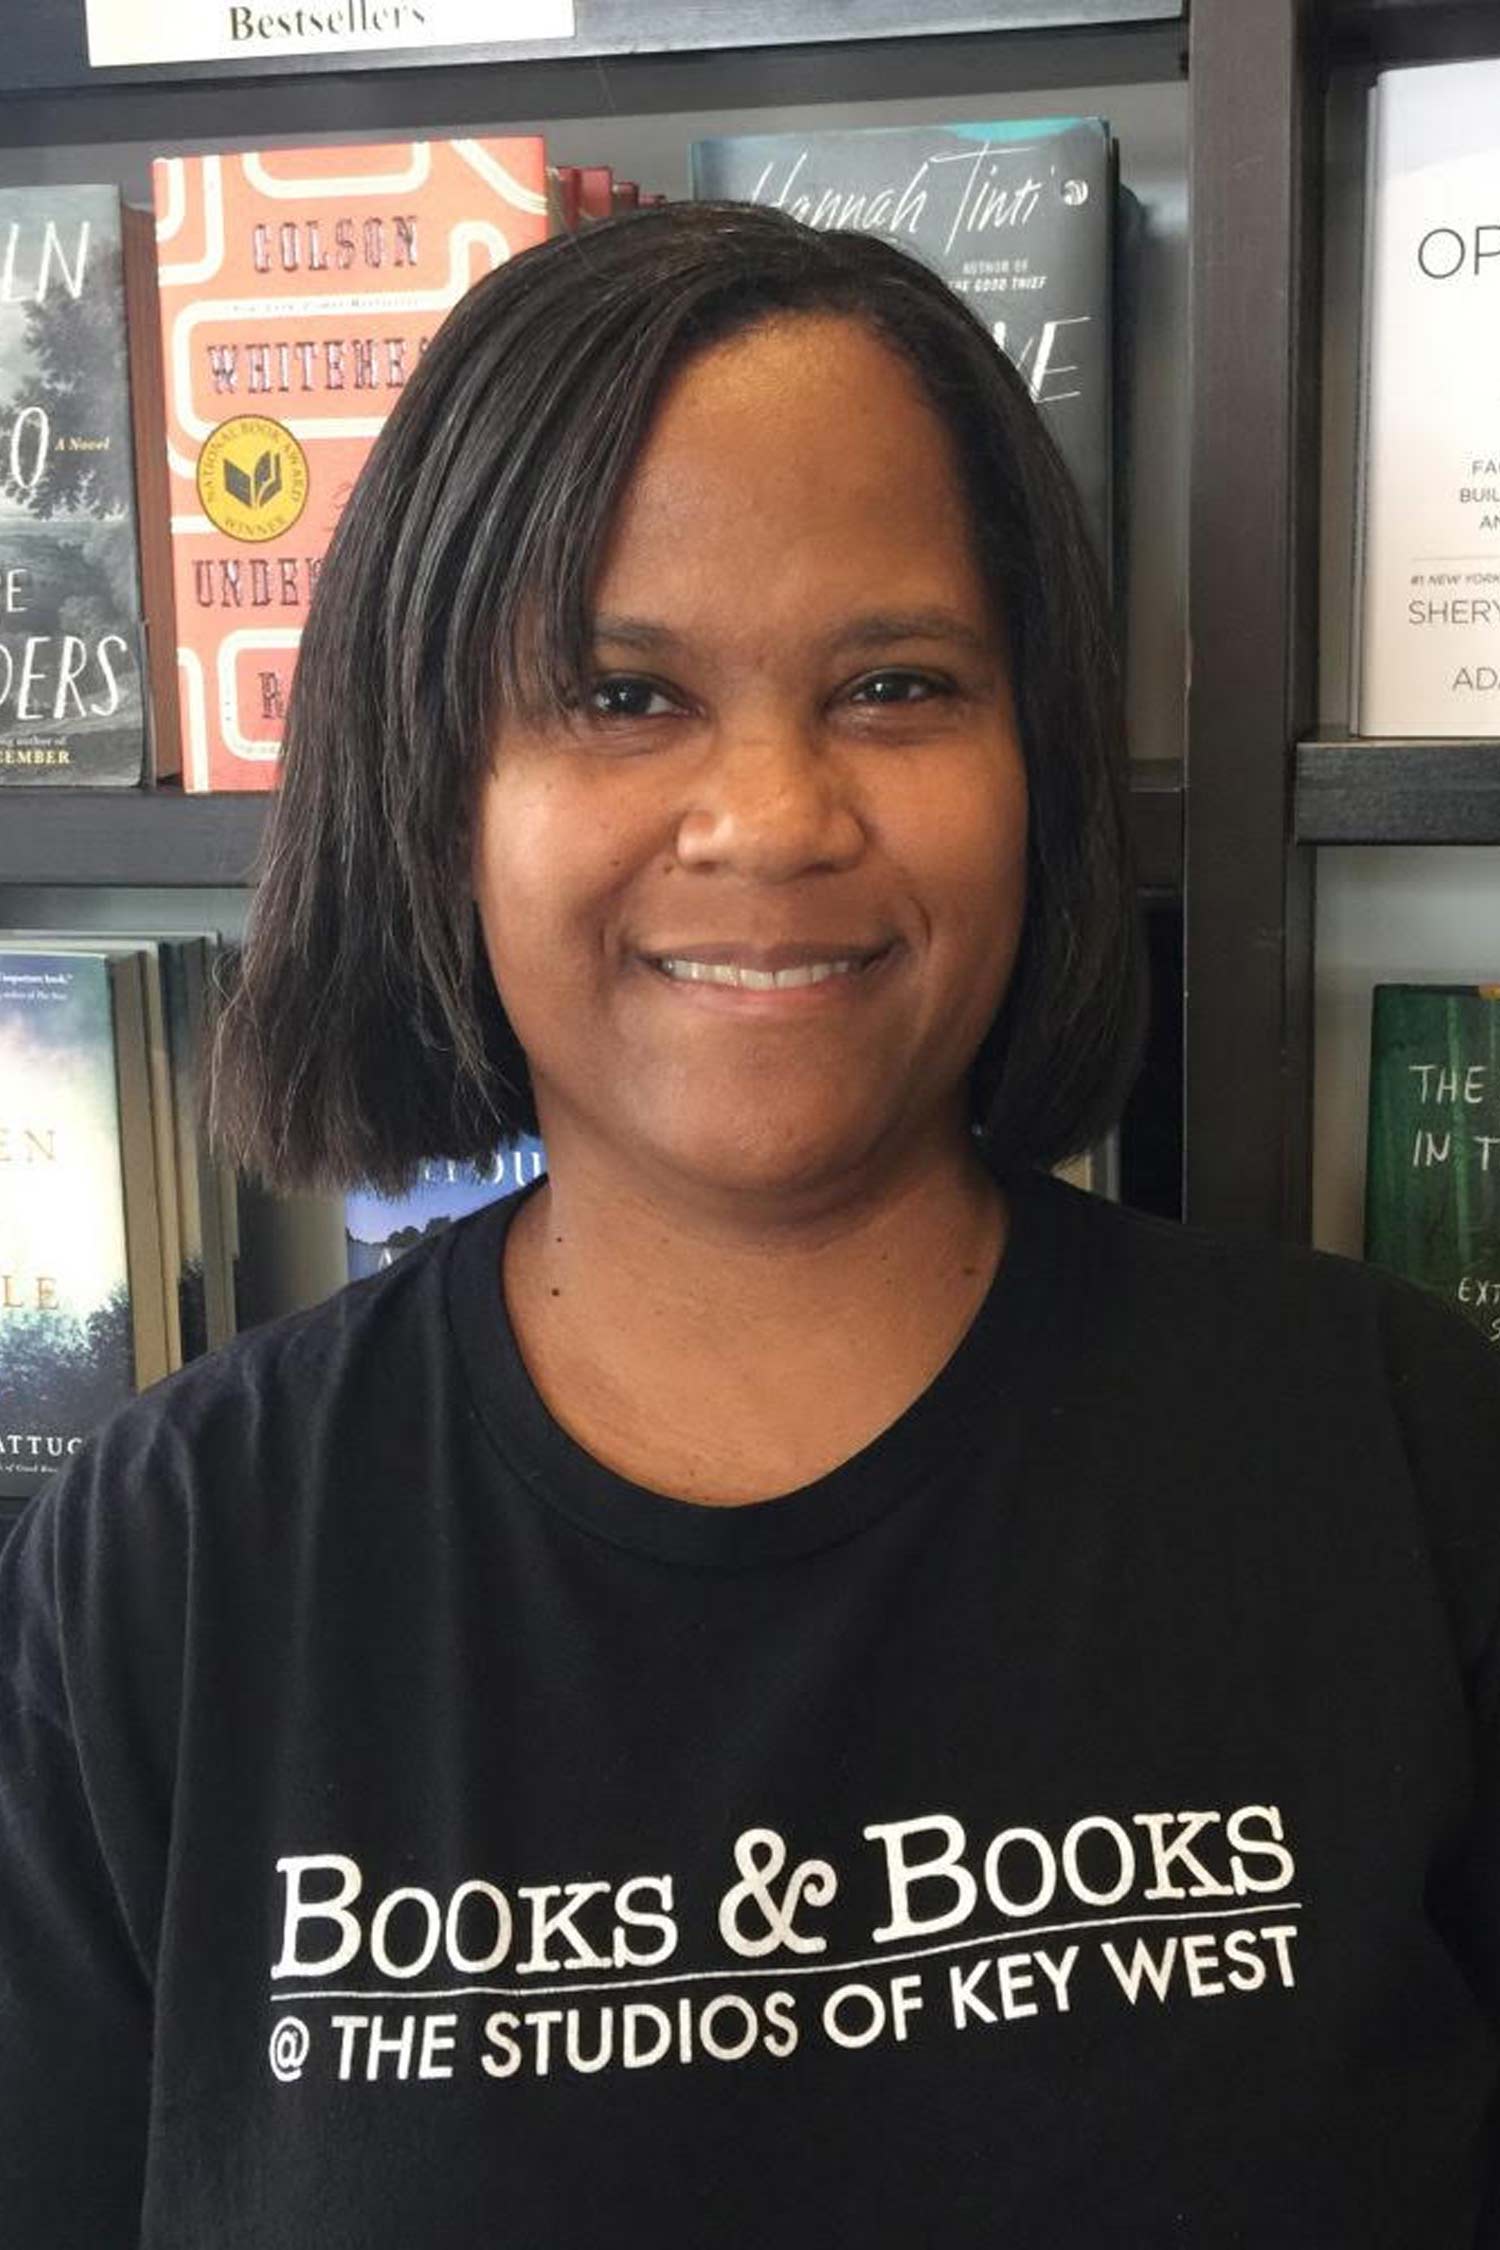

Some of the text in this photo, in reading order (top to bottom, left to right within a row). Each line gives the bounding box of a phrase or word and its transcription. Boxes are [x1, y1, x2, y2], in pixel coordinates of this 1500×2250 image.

[229, 0, 426, 41] Bestsellers
[750, 141, 1053, 256] Hannah Tinti
[252, 214, 419, 274] COLSON
[1417, 224, 1500, 279] OP
[962, 258, 1029, 275] AUTHOR OF
[974, 276, 1008, 292] GOOD
[1012, 275, 1048, 290] THIEF
[207, 335, 429, 396] WHITEHE
[69, 436, 111, 451] Novel
[240, 422, 281, 443] BOOK
[284, 443, 303, 503] AWARD
[1472, 459, 1500, 475] FA
[225, 515, 285, 536] WINNER
[1428, 575, 1460, 586] NEW
[1451, 666, 1500, 691] AD
[1409, 1065, 1487, 1105] THE
[1413, 1129, 1451, 1167] IN
[718, 1827, 838, 1954] &
[269, 1925, 1298, 2082] @ THE STUDIOS OF KEY WEST
